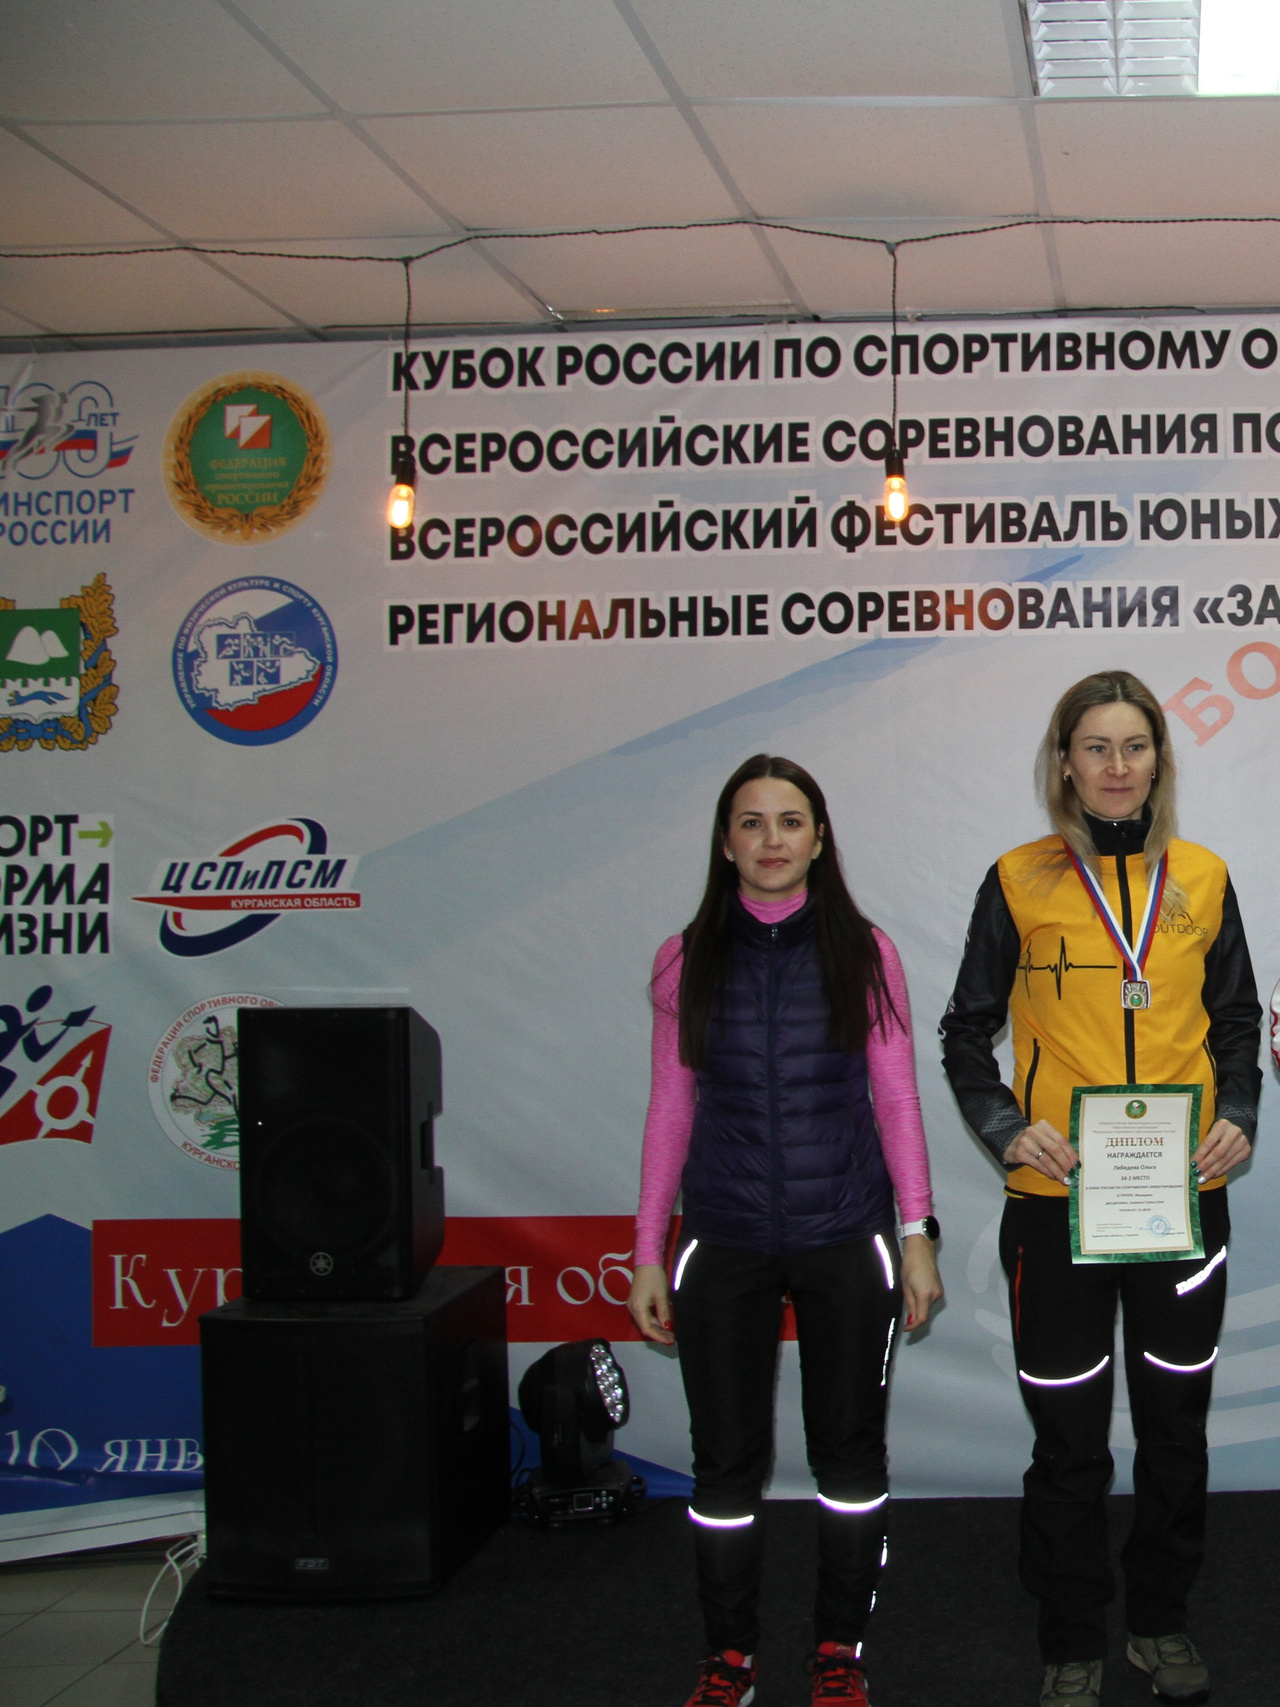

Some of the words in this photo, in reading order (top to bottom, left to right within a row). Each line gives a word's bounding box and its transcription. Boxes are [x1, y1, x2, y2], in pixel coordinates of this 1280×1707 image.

[392, 346, 545, 391] КУБОК
[556, 340, 760, 387] РОССИИ
[773, 337, 841, 379] ПО
[853, 329, 1230, 376] СПОРТИВНОМУ
[86, 412, 120, 427] ЛЕТ
[391, 416, 810, 475] ВСЕРОССИЙСКИЕ
[823, 411, 1218, 461] СОРЕВНОВАНИЯ
[217, 491, 278, 505] РОССИИ
[391, 496, 817, 560] ВСЕРОССИЙСКИЙ
[831, 500, 1127, 552] ФЕСТИВАЛЬ
[389, 594, 768, 645] РЕГИОНАЛЬНЫЕ
[781, 585, 1179, 635] СОРЕВНОВАНИЯ
[0, 862, 110, 906] РМА
[161, 859, 348, 893] ЦСПиПСМ
[231, 898, 301, 910] КУРГАНСКАЯ
[303, 897, 356, 908] ОБЛАСТЬ
[149, 1021, 185, 1084] ФЕДЕРАЦИЯ
[183, 995, 259, 1023] СПОРТИВНОГО
[1105, 1137, 1164, 1148] ДИПЛОМ
